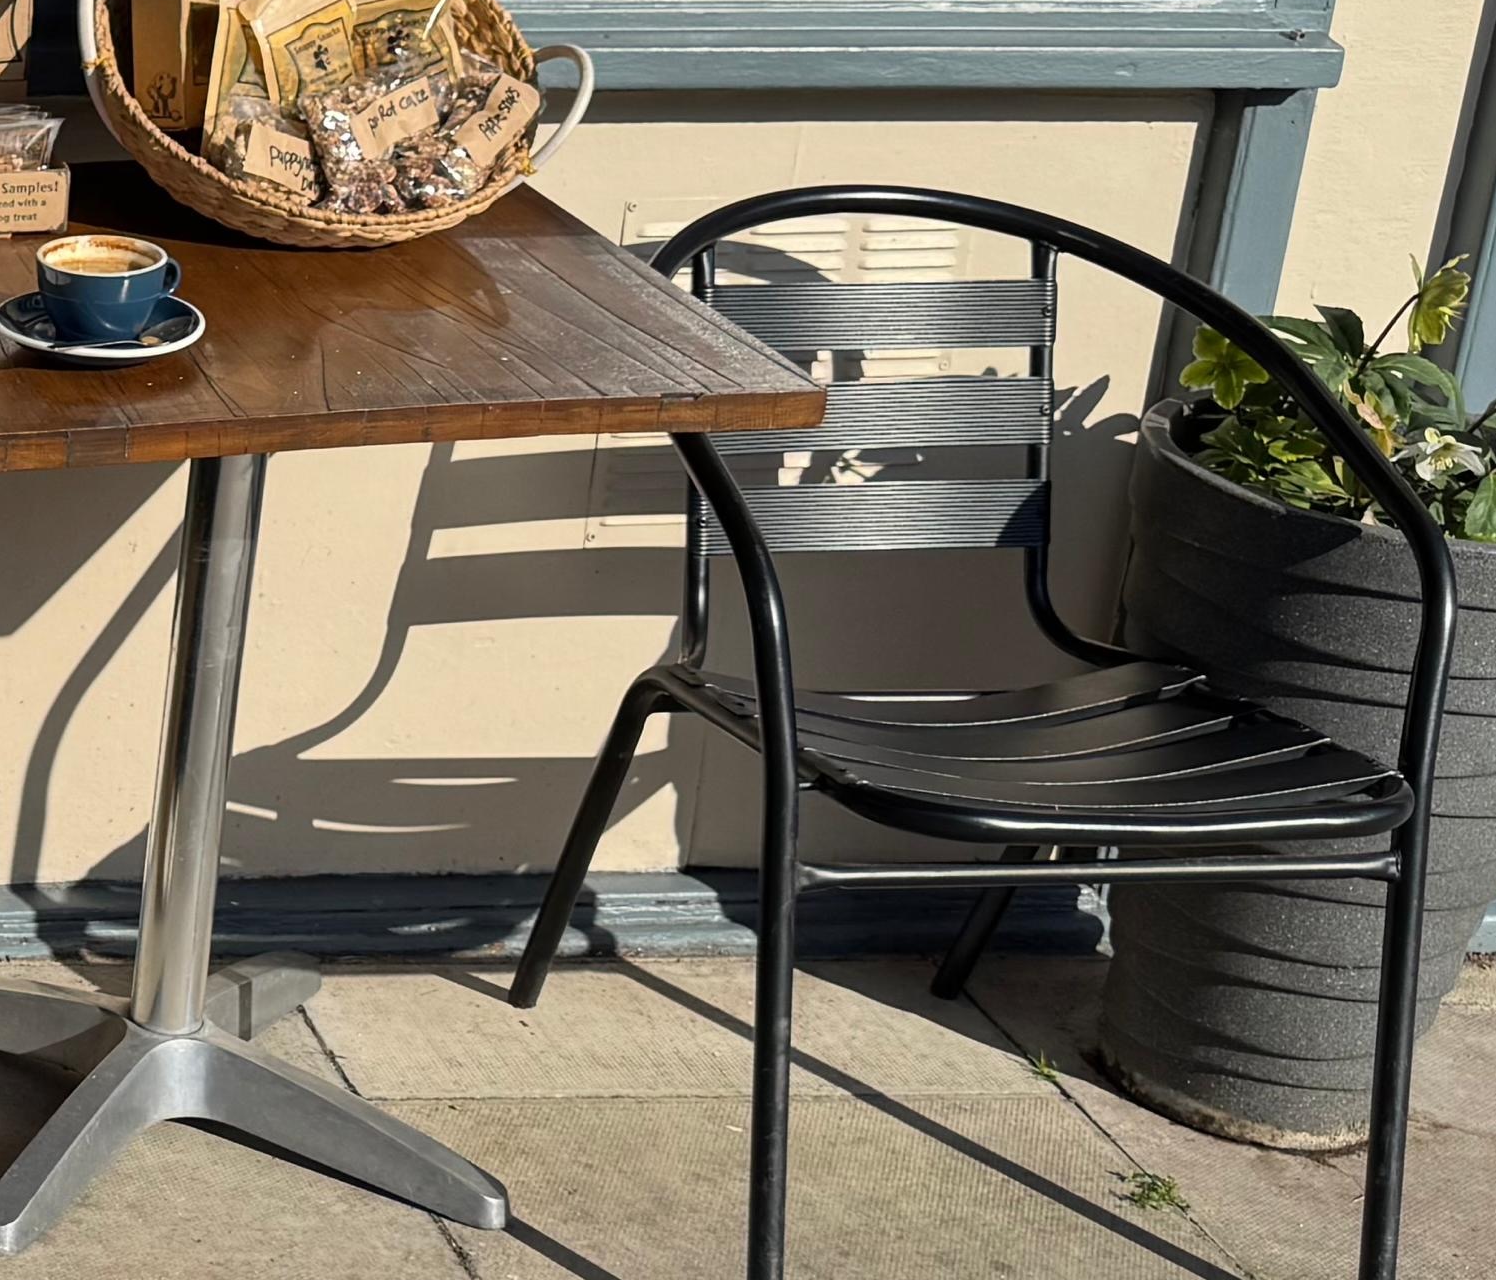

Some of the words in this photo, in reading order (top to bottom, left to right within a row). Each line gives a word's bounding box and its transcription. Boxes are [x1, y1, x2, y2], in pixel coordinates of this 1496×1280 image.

[1, 181, 59, 195] Samples!
[17, 197, 37, 208] with
[40, 199, 47, 207] a
[13, 212, 37, 222] treat
